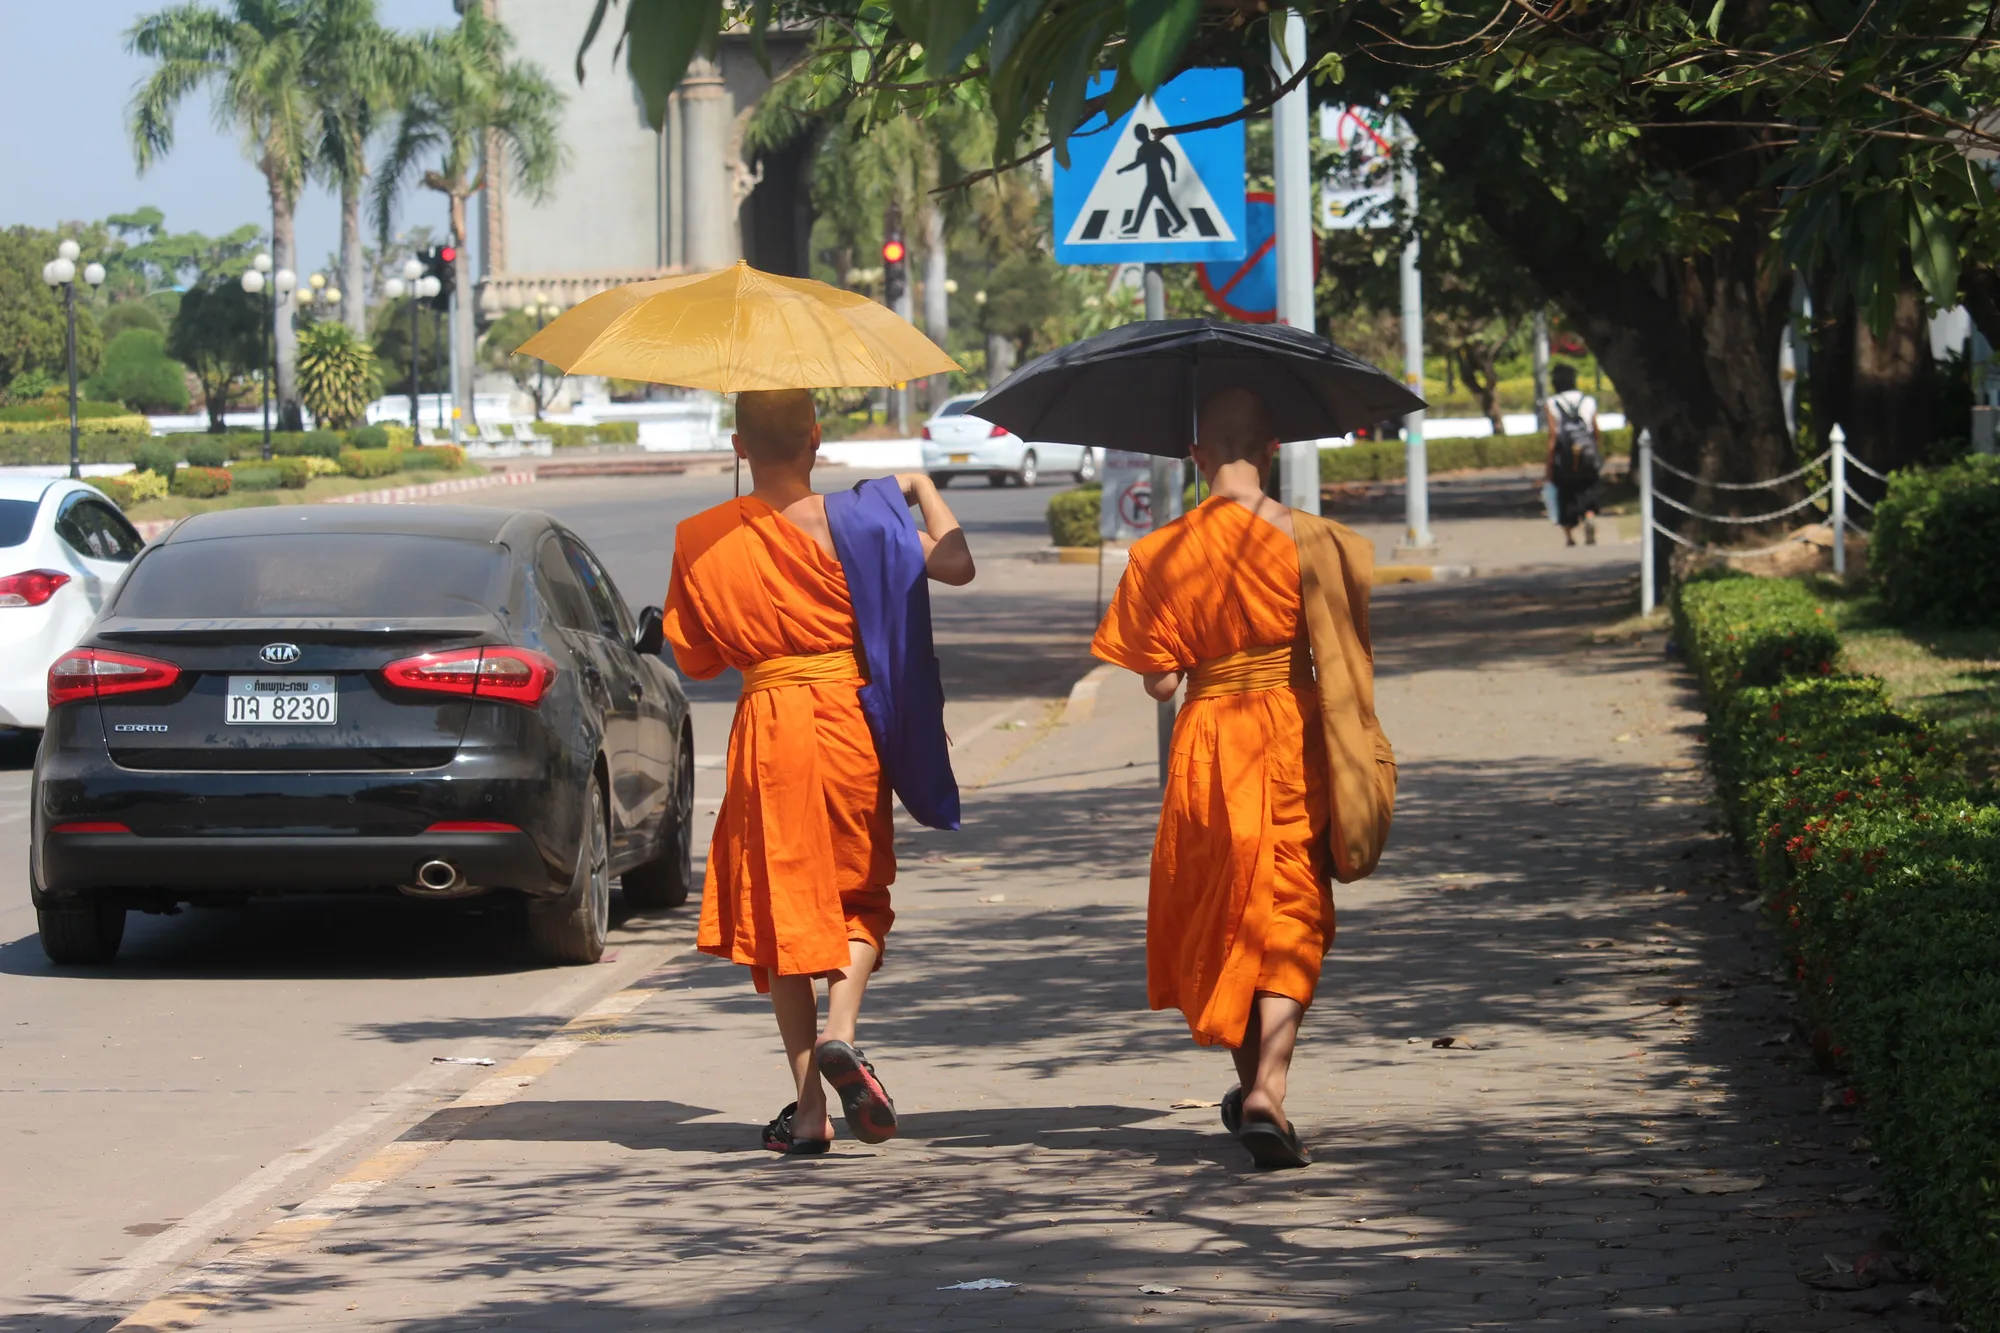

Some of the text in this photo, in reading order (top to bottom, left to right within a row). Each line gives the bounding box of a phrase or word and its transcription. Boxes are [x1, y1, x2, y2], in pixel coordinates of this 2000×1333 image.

[265, 647, 295, 660] KIA
[272, 696, 330, 720] 8230
[114, 724, 169, 732] CERATO
